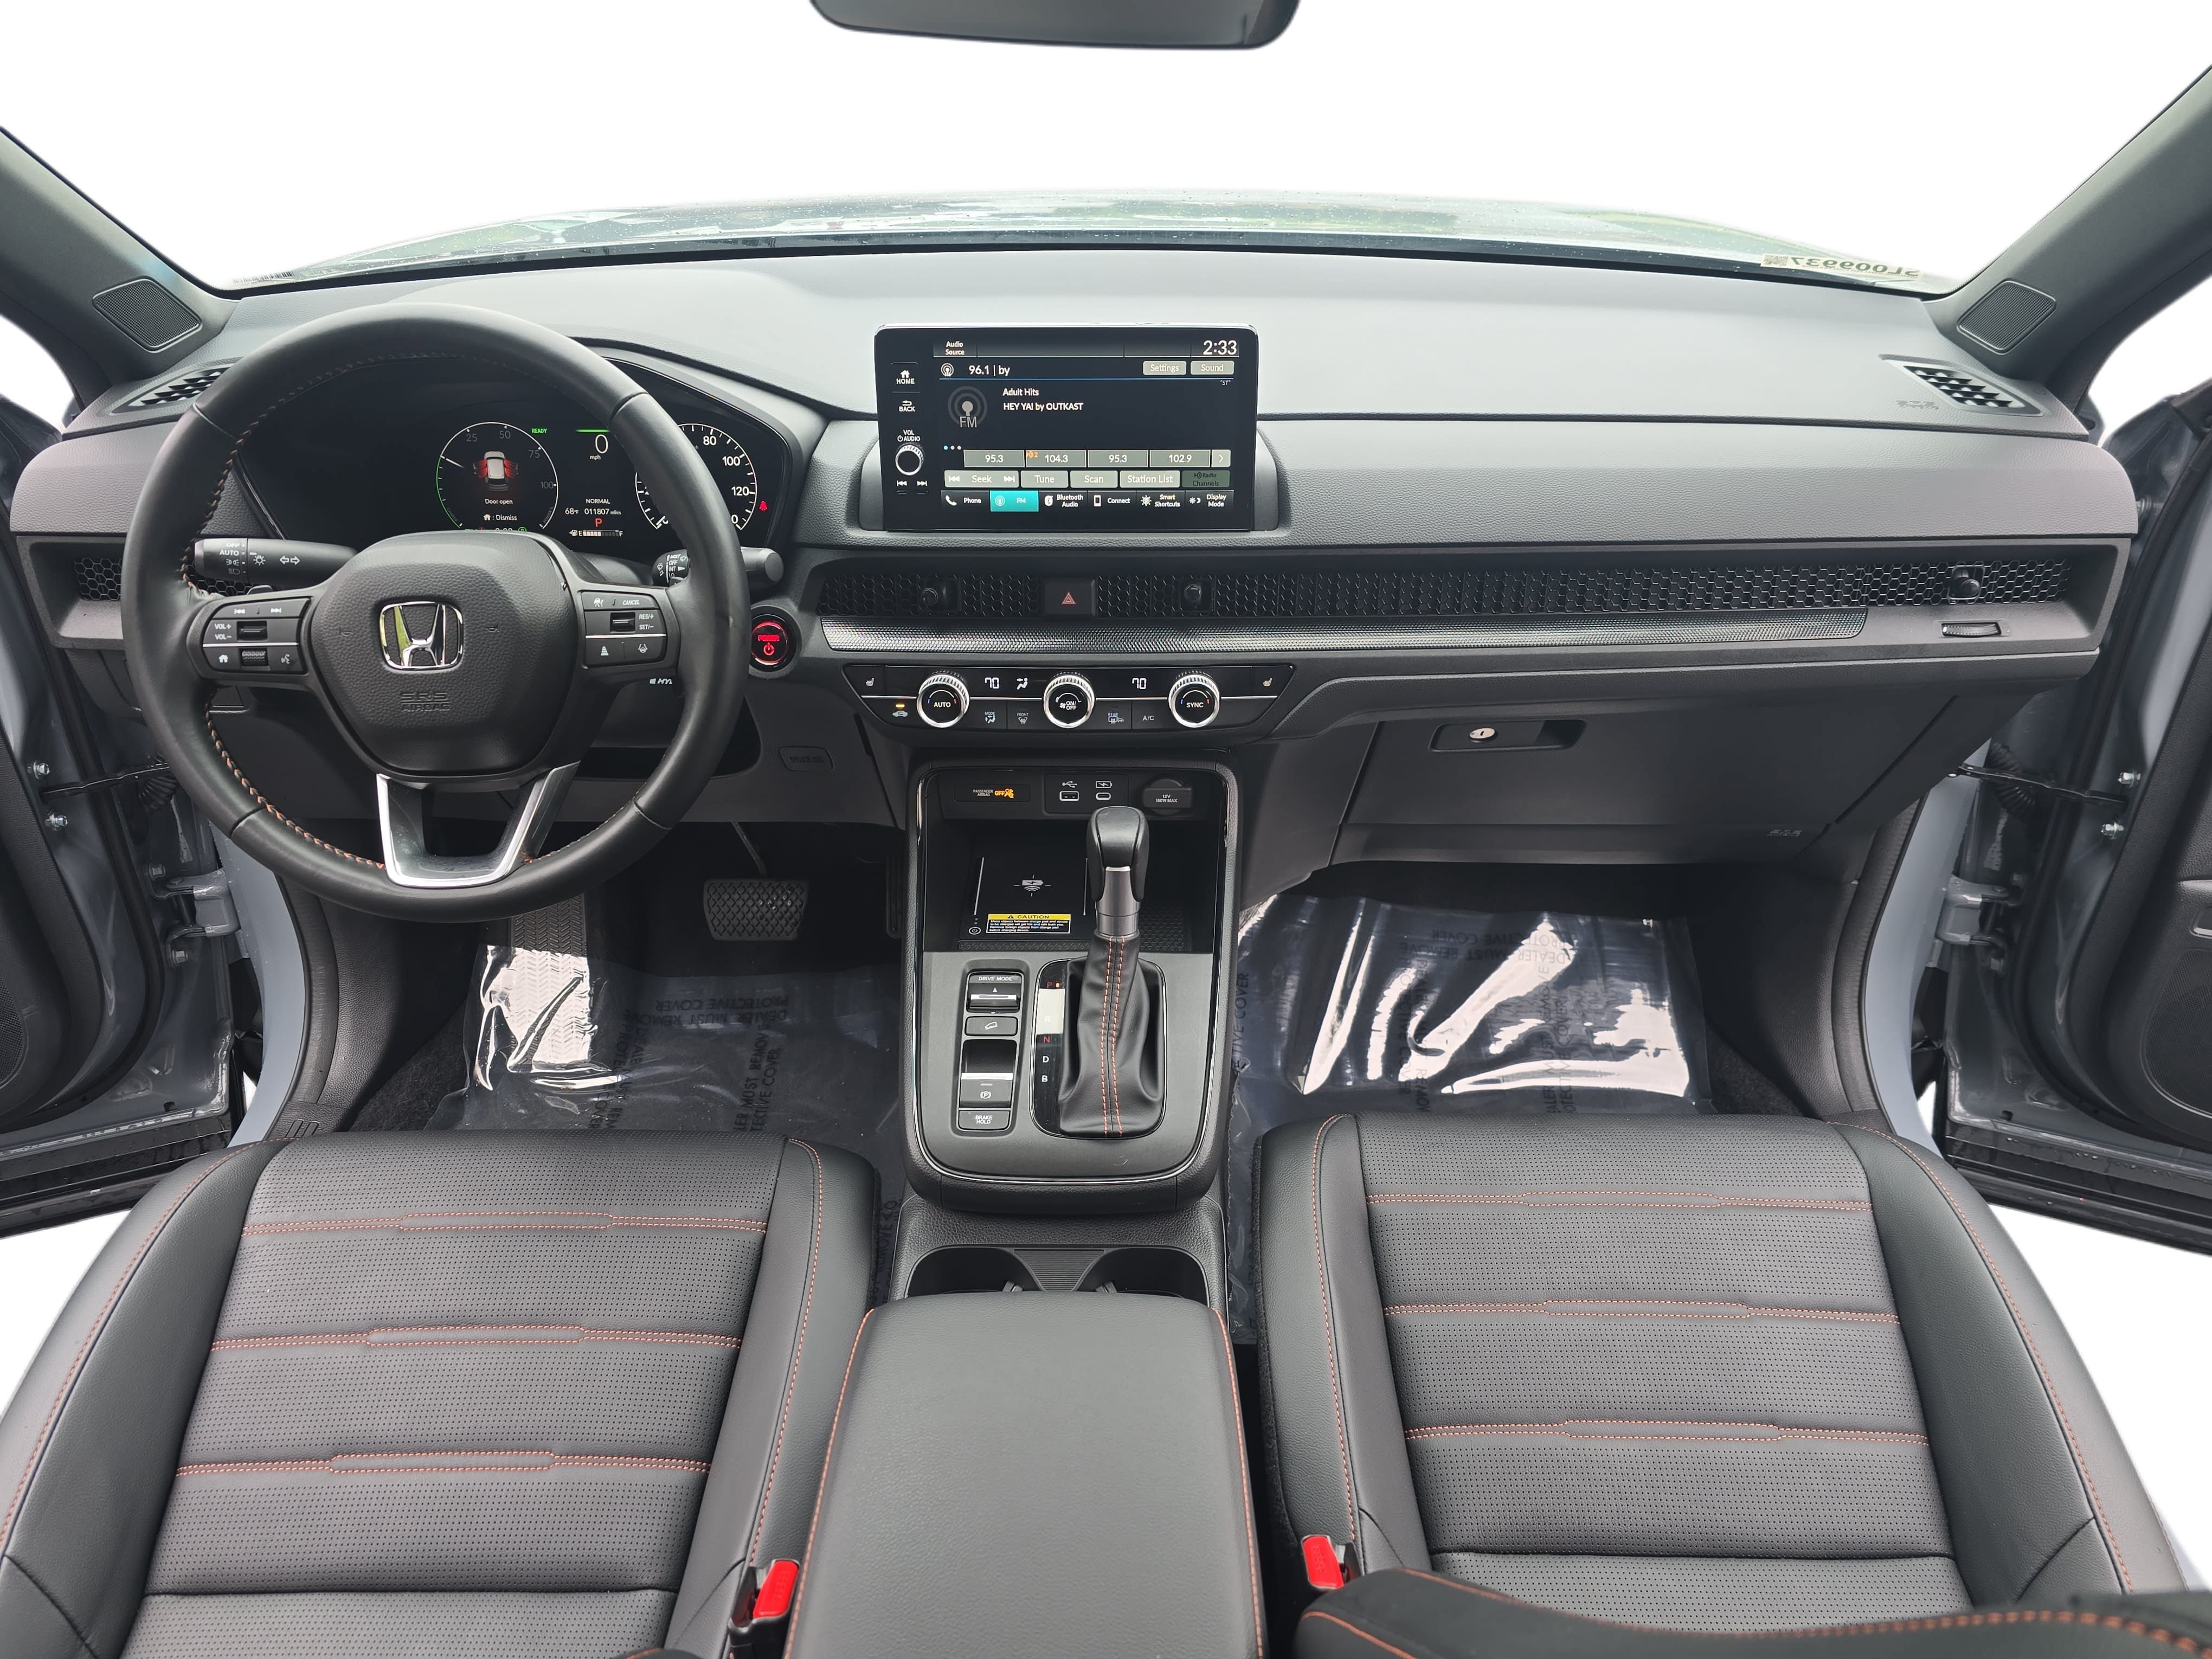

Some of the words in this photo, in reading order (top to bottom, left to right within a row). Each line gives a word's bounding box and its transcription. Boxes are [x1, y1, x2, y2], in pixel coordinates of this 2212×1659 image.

[1203, 340, 1237, 356] 2:33
[968, 365, 989, 375] 96.1
[998, 365, 1010, 376] by
[1150, 364, 1179, 372] Settings
[1201, 364, 1224, 372] Sound
[1035, 403, 1044, 412] by
[1046, 402, 1084, 410] OUTKAST
[960, 416, 977, 428] FM
[466, 434, 478, 442] 25
[499, 430, 511, 439] 50
[595, 434, 608, 454] 0
[703, 435, 717, 446] 80
[528, 449, 541, 459] 75
[985, 454, 1004, 462] 95.3
[1045, 454, 1068, 462] 104.3
[1109, 454, 1128, 463] 95.3
[1169, 454, 1192, 463] 102.9
[722, 456, 741, 466] 100
[972, 475, 992, 484] Seek
[1034, 475, 1054, 484] Tune
[1084, 475, 1104, 484] Scan
[1127, 474, 1156, 484] Station
[1159, 474, 1173, 484] List
[541, 481, 554, 489] 100
[731, 486, 749, 496] 120
[595, 518, 602, 527] P
[985, 677, 1000, 690] 70
[1132, 677, 1147, 690] 70
[1517, 949, 1566, 964] DEALER
[1234, 973, 1249, 1019] COVER
[655, 999, 703, 1012] COVER
[708, 995, 788, 1010] PROTECTIVE
[689, 1013, 728, 1025] MUST
[736, 1009, 787, 1025] DEALER
[762, 1047, 781, 1086] COVER
[740, 1077, 758, 1108] MUST
